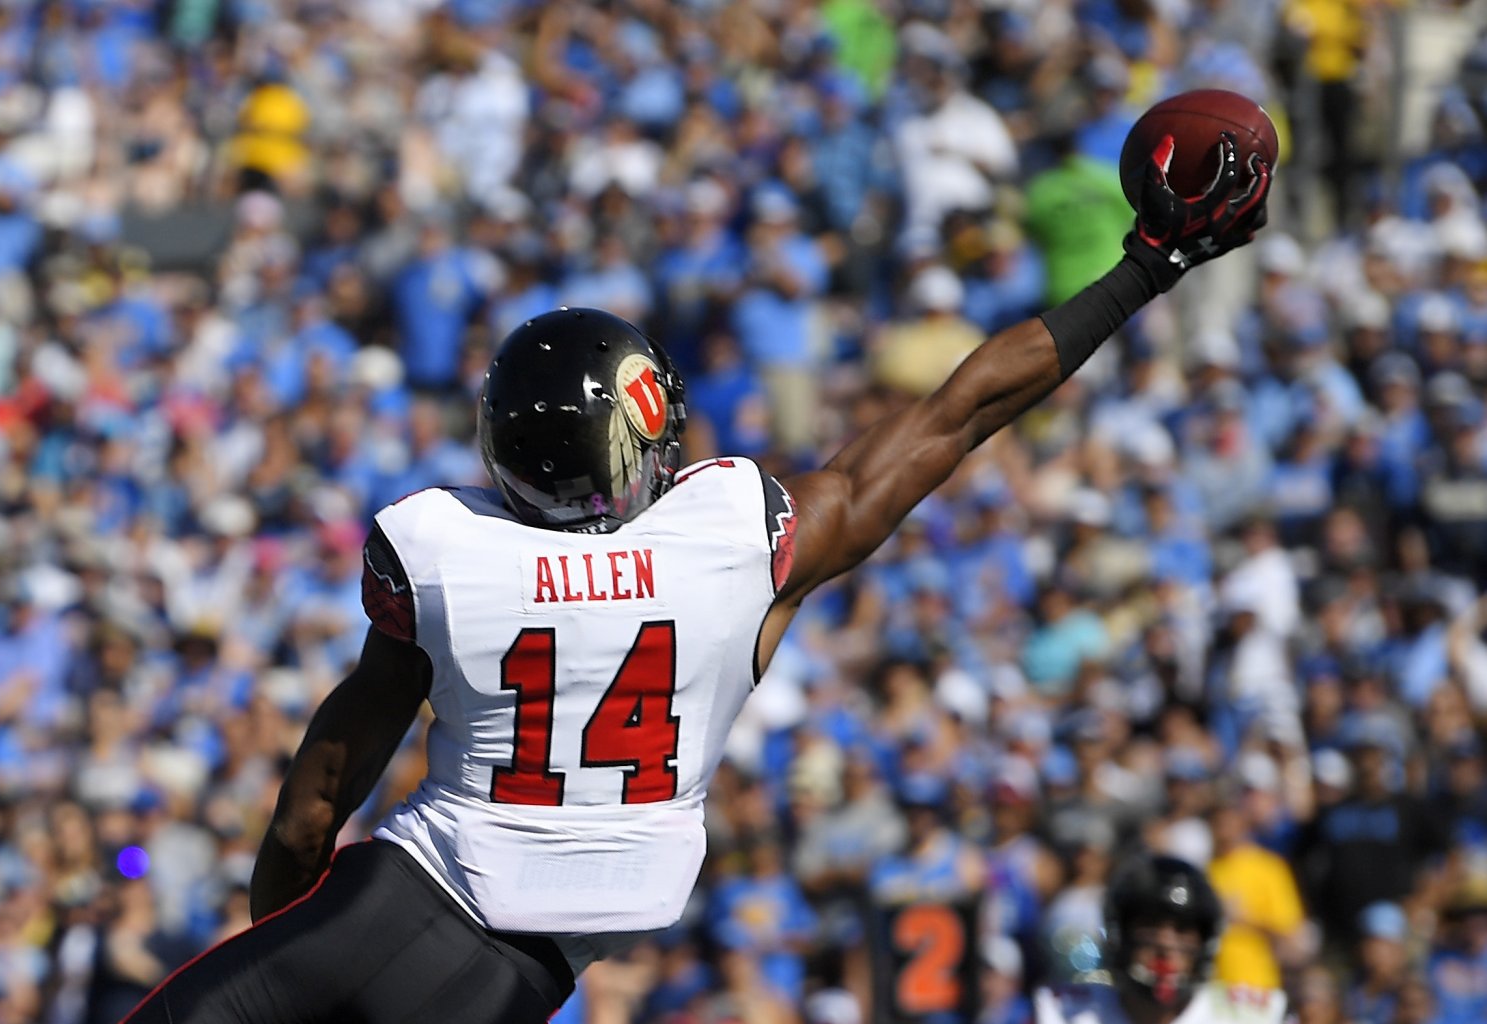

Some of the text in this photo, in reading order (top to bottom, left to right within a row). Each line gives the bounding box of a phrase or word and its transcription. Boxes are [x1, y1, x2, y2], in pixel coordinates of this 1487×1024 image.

[624, 366, 665, 435] U
[534, 548, 655, 603] ALLEN
[489, 619, 681, 807] 14
[893, 904, 965, 1013] 2
